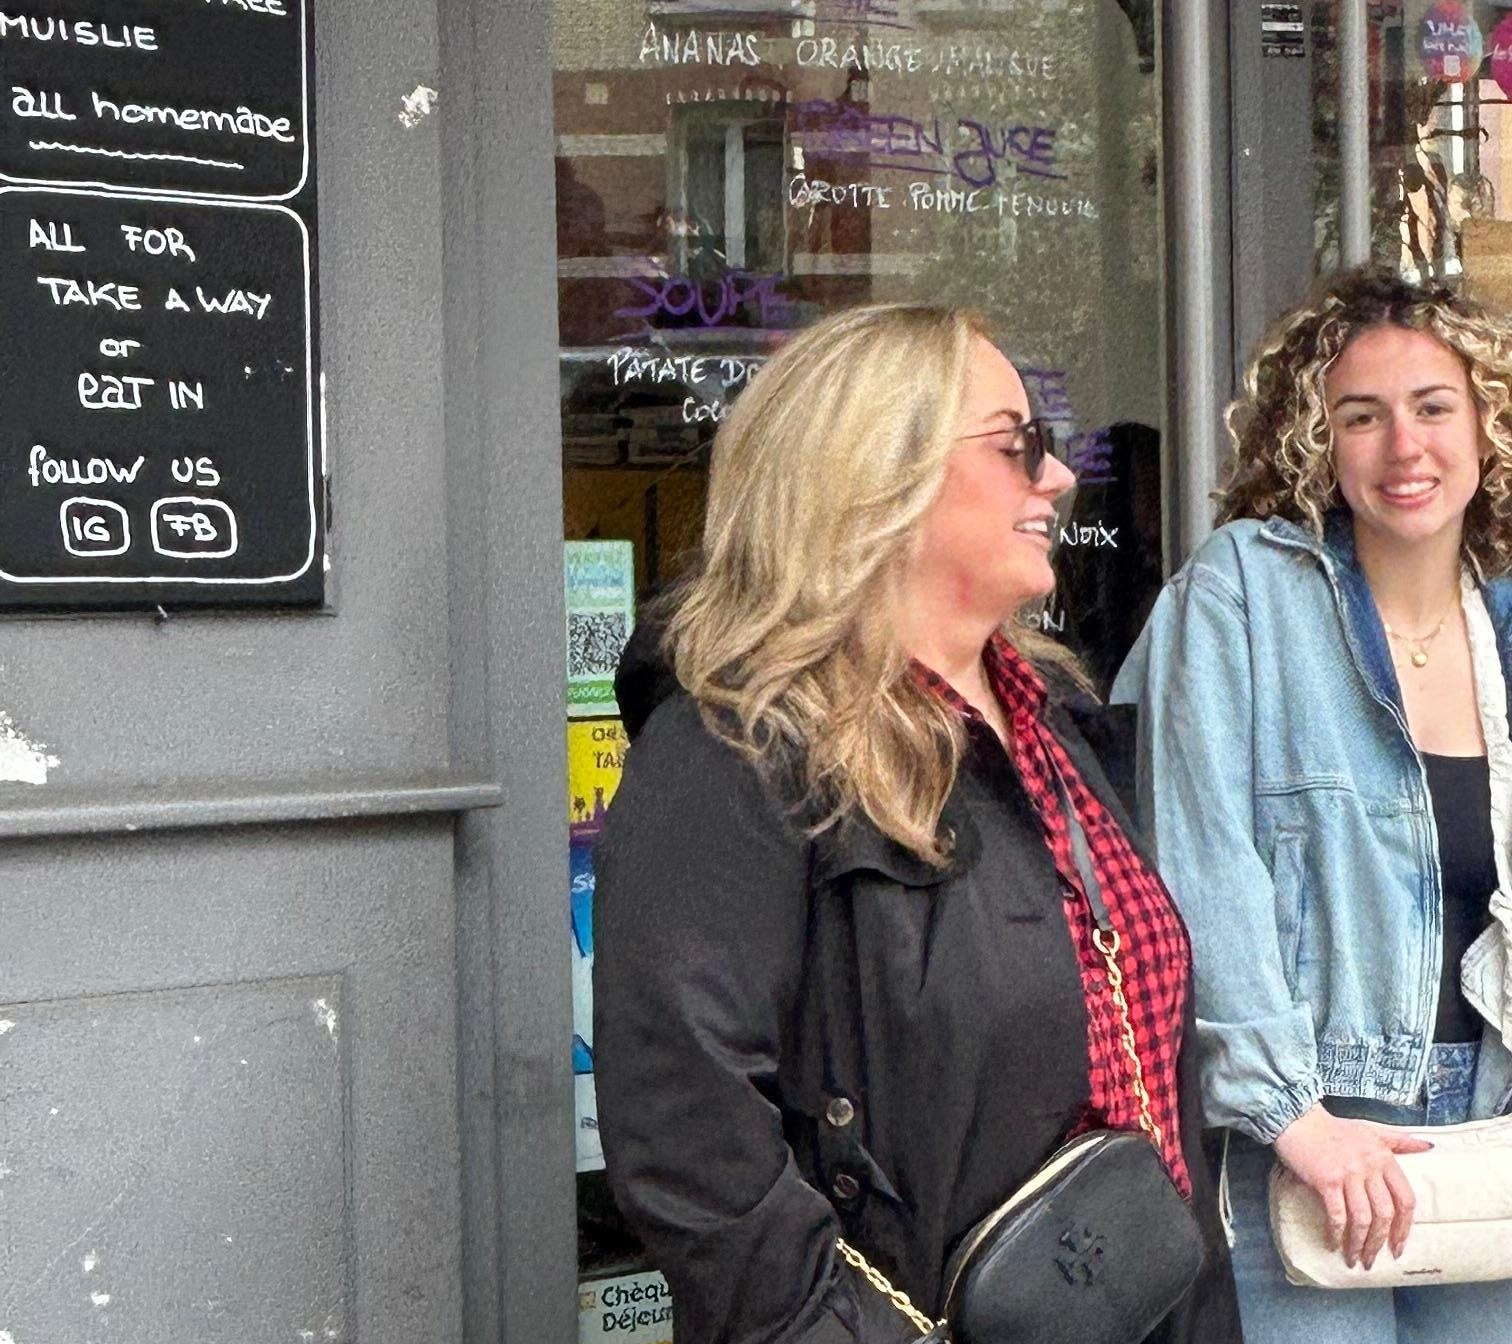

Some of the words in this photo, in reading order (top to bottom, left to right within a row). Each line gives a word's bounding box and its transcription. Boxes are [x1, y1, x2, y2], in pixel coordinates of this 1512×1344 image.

[0, 11, 158, 50] MUISLIE
[639, 22, 761, 67] ANANAS
[28, 219, 86, 252] ALL
[121, 224, 196, 262] FOR
[37, 276, 142, 311] TAKE
[167, 380, 205, 410] IN
[72, 515, 111, 542] IG
[162, 512, 217, 542] FB
[601, 1281, 672, 1308] Chèqu
